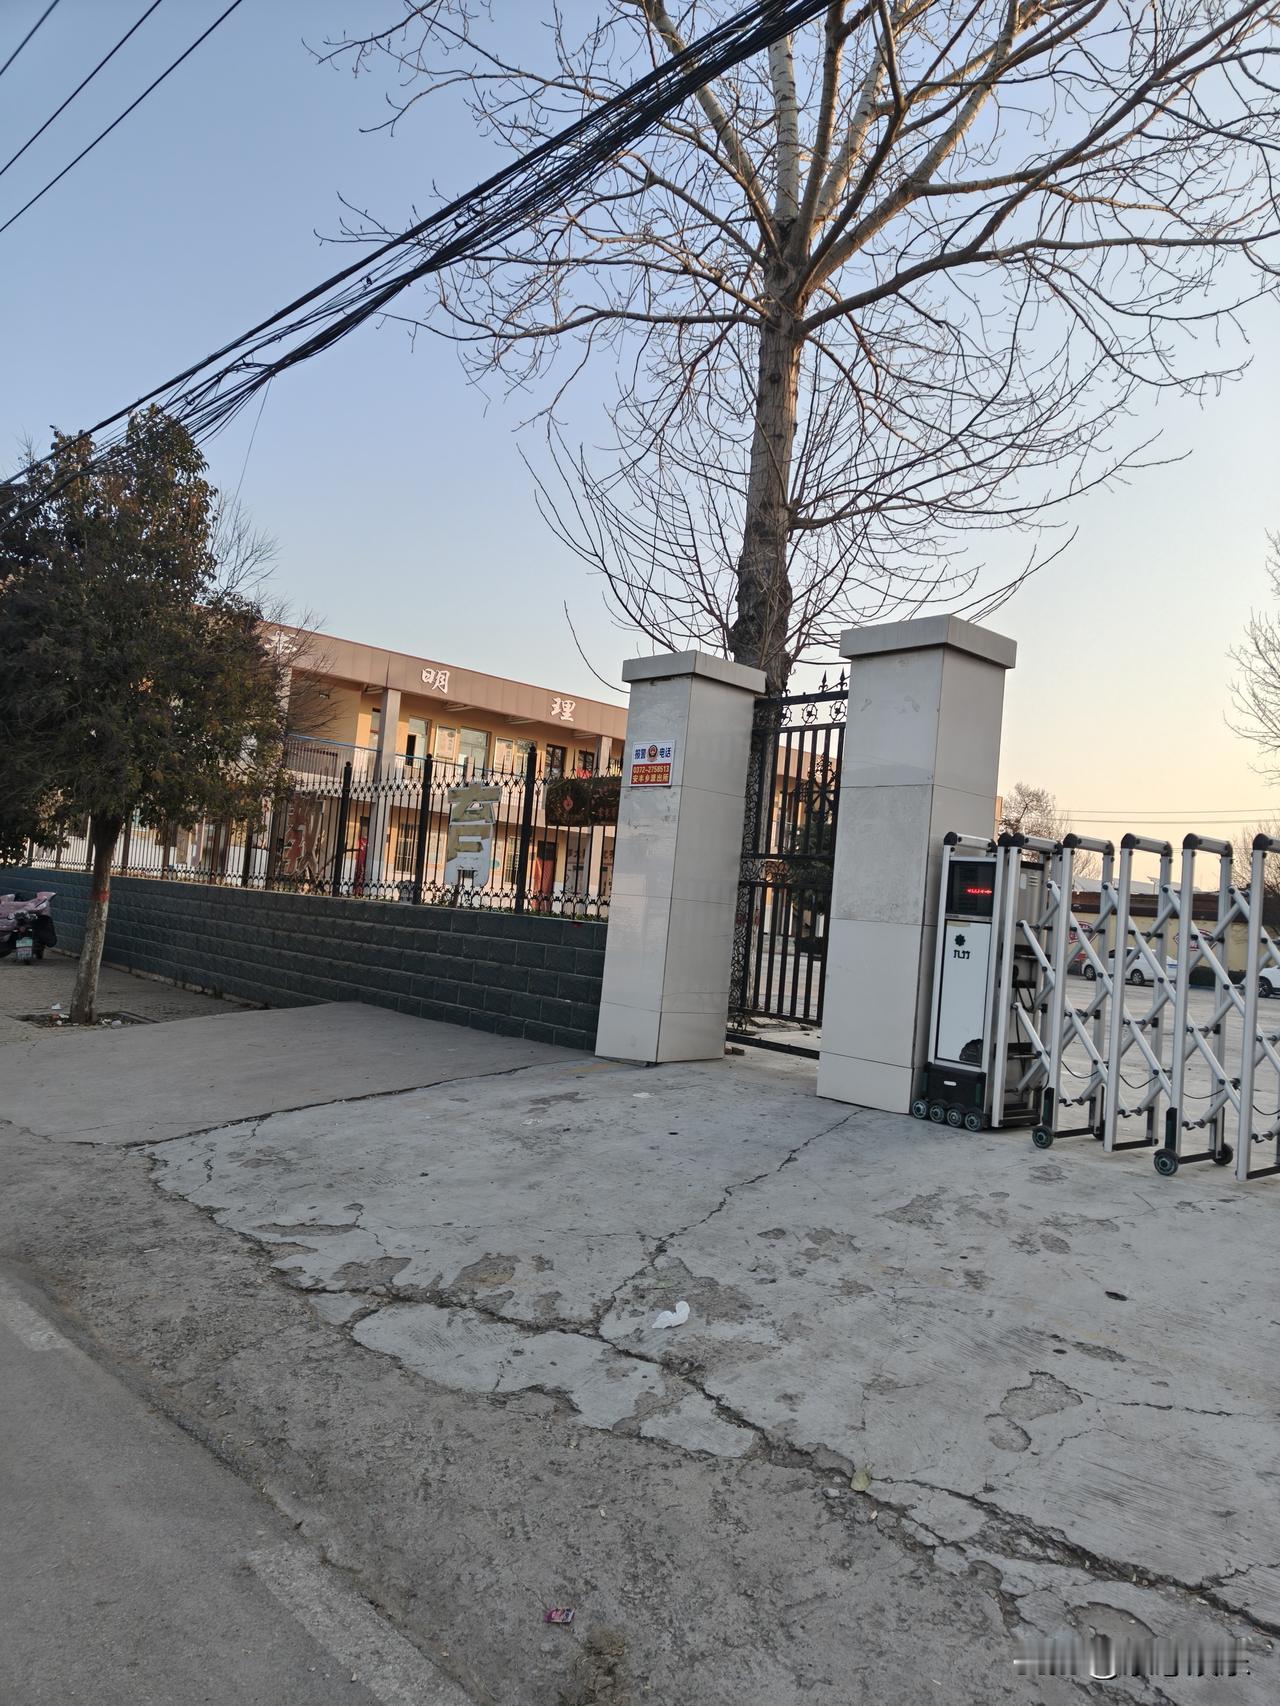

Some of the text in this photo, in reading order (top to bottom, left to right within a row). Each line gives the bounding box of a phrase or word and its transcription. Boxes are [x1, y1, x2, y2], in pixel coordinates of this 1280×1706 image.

[421, 668, 576, 722] 明 理
[635, 746, 671, 758] 报警 电话
